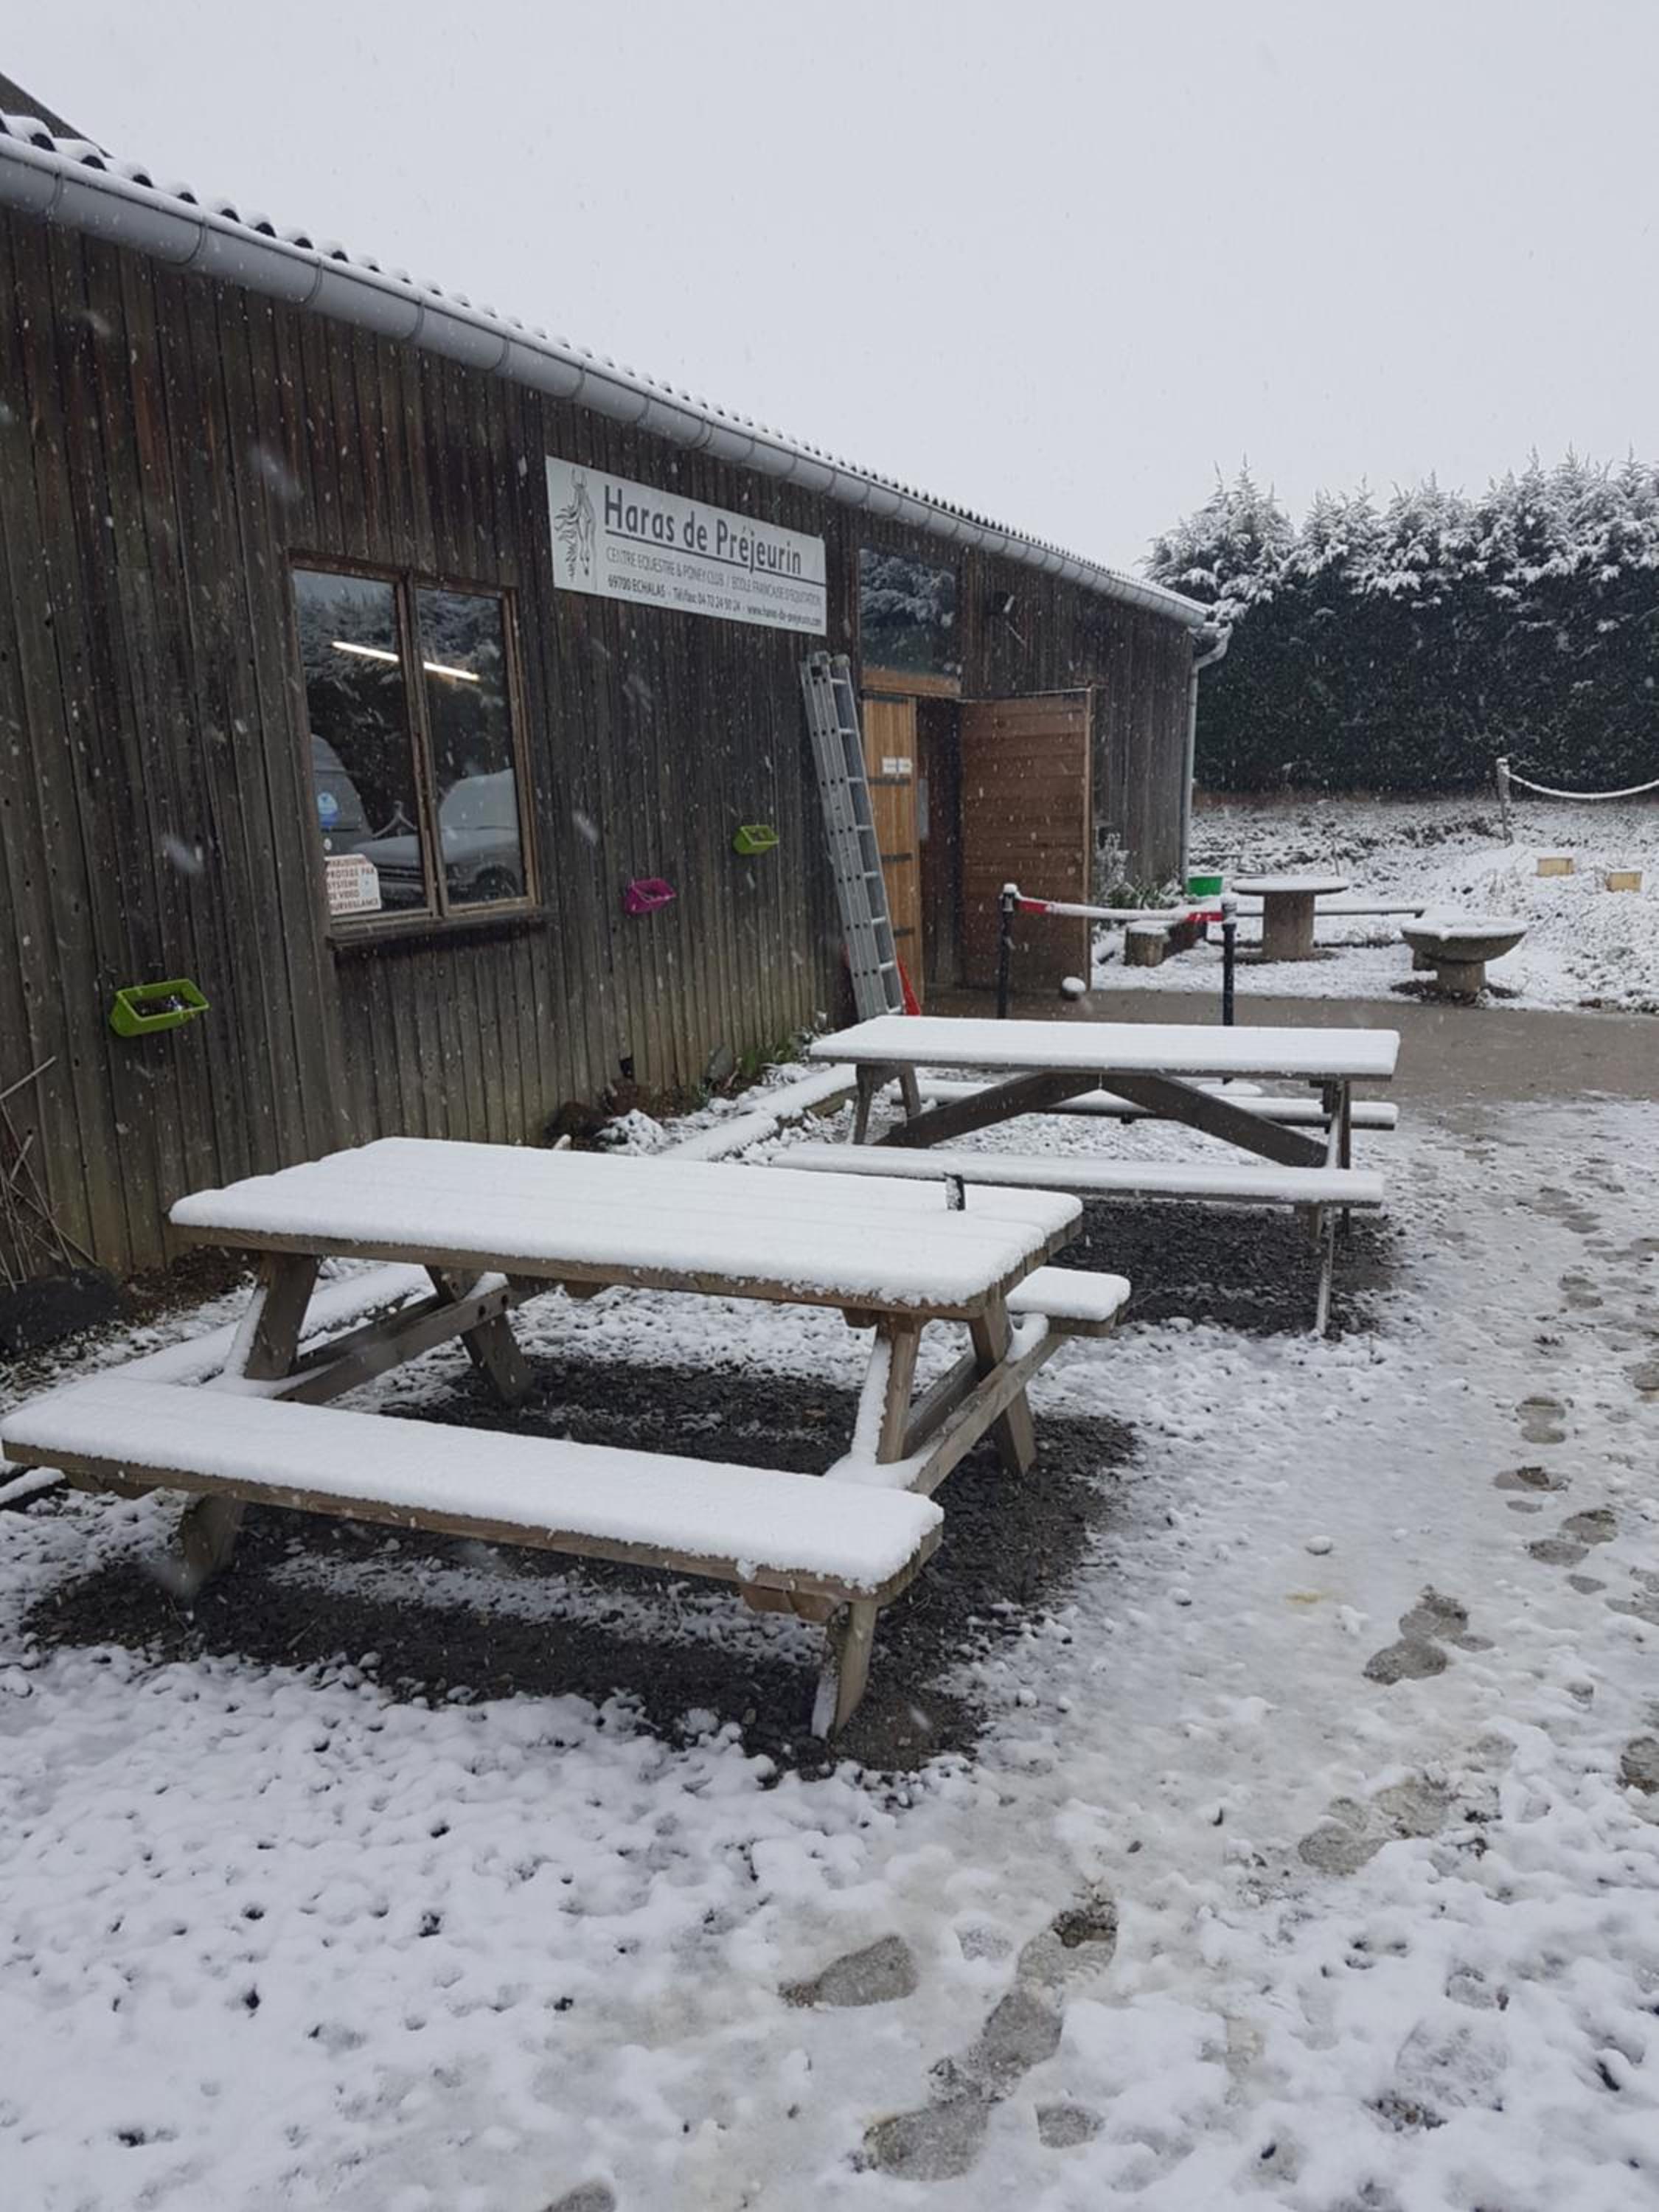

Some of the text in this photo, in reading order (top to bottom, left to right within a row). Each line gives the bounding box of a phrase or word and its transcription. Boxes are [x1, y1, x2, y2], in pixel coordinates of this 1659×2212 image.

[605, 484, 801, 574] Haras de Préjeurin
[606, 546, 636, 567] CENTRE
